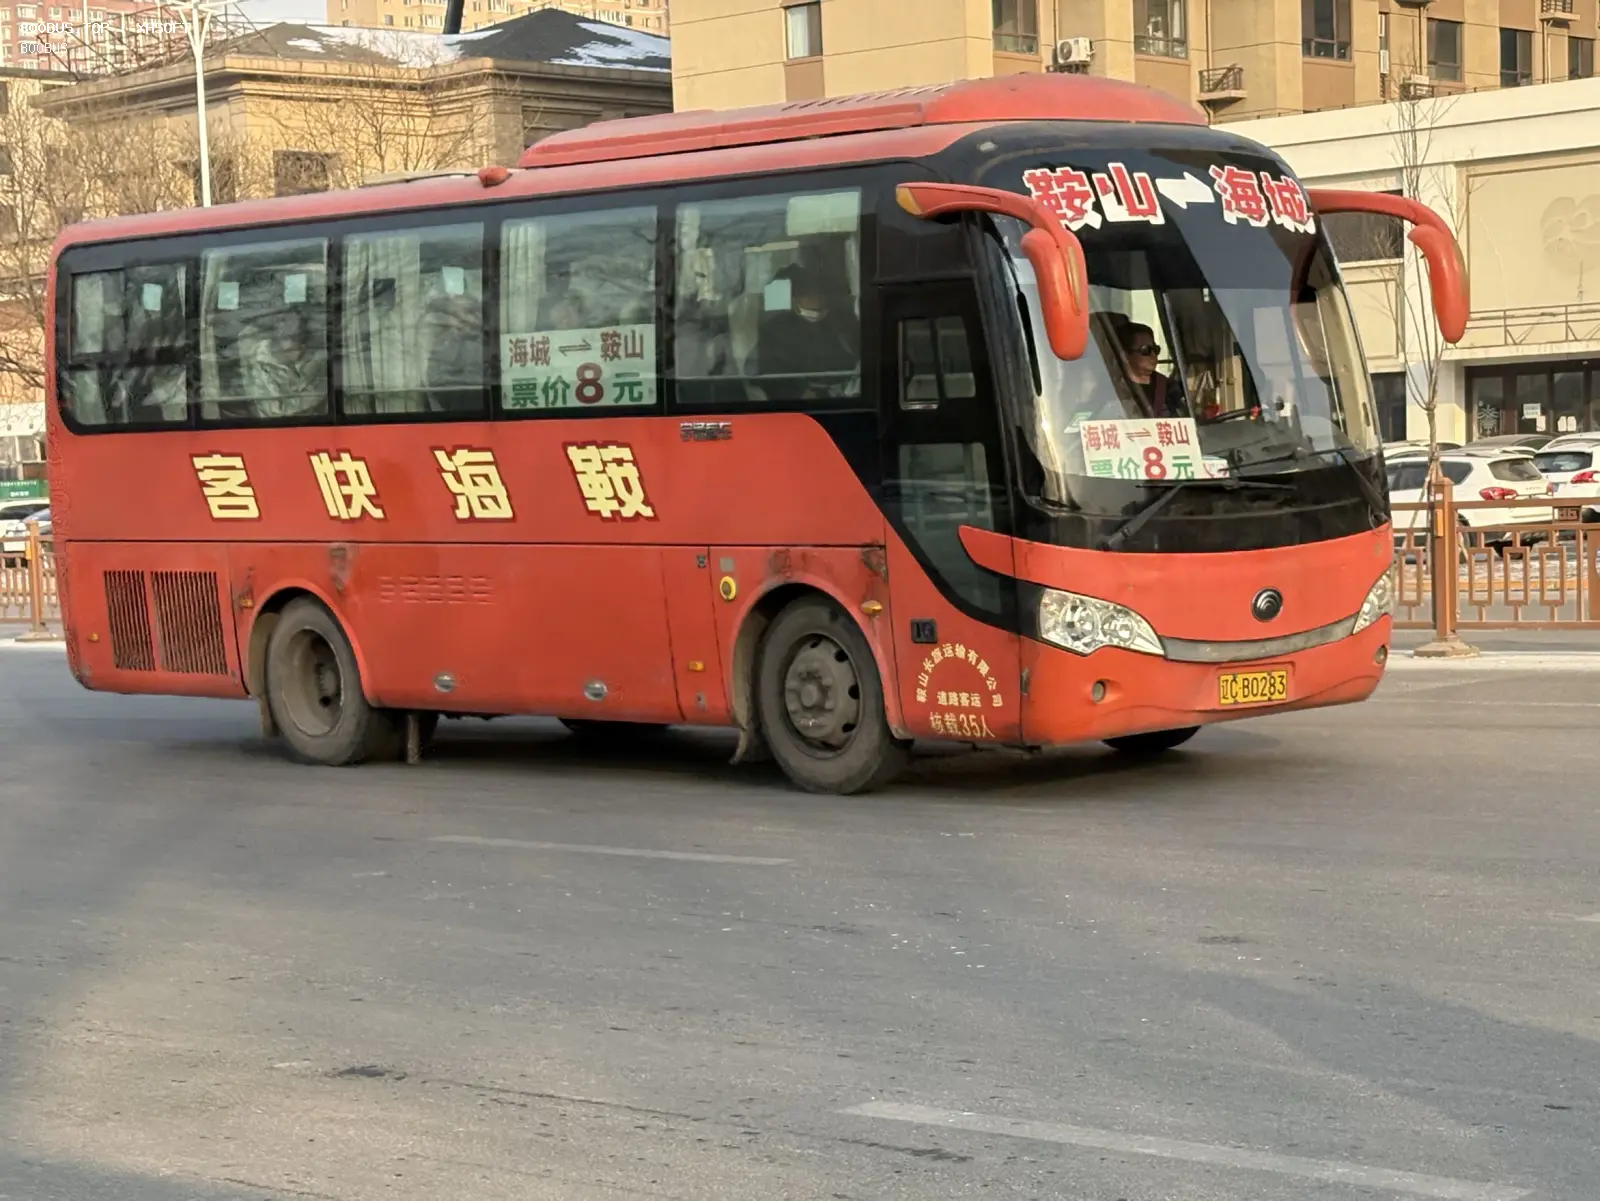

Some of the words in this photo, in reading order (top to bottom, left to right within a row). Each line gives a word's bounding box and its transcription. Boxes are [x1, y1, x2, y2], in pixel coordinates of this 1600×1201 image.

[1023, 162, 1165, 231] 鞍山
[1209, 164, 1316, 234] 海城
[508, 335, 551, 368] 海城
[600, 329, 645, 362] 鞍山
[1083, 423, 1121, 451] 海城
[1155, 421, 1191, 448] 鞍山
